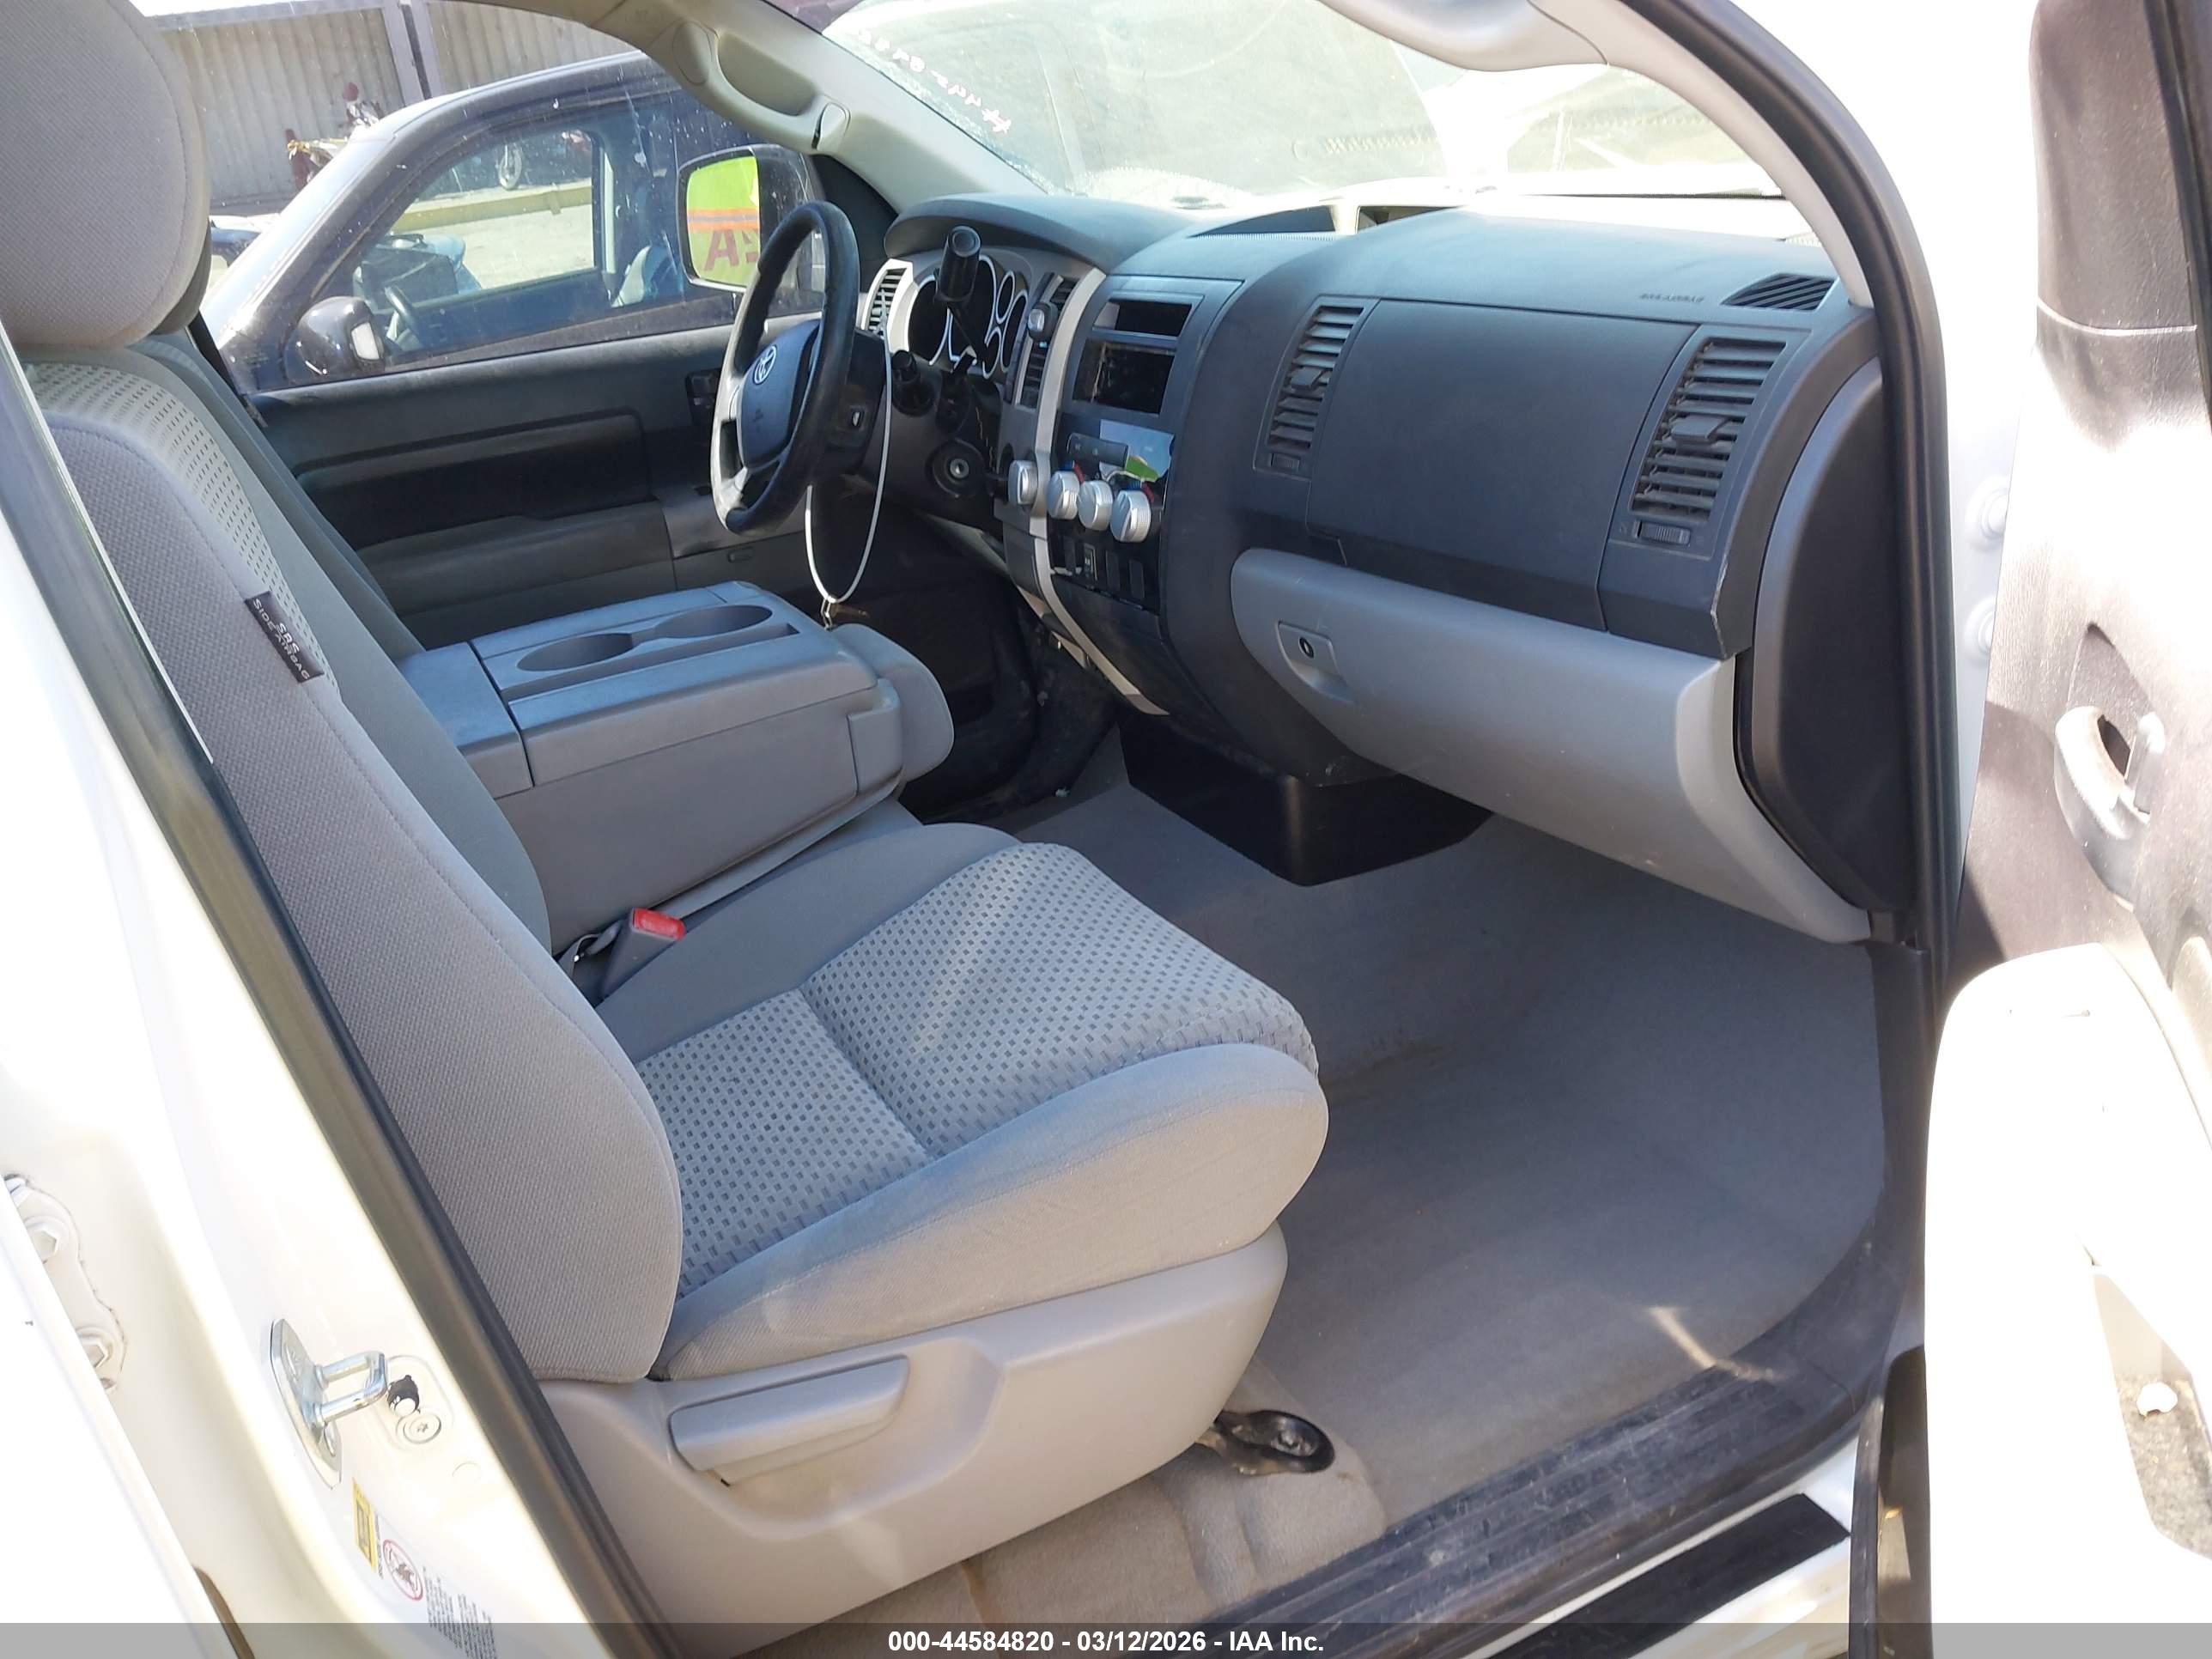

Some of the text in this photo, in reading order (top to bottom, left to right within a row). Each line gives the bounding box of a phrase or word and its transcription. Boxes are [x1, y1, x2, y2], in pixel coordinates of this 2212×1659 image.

[252, 598, 311, 680] SIDE AIRBAG
[278, 622, 301, 654] SRS
